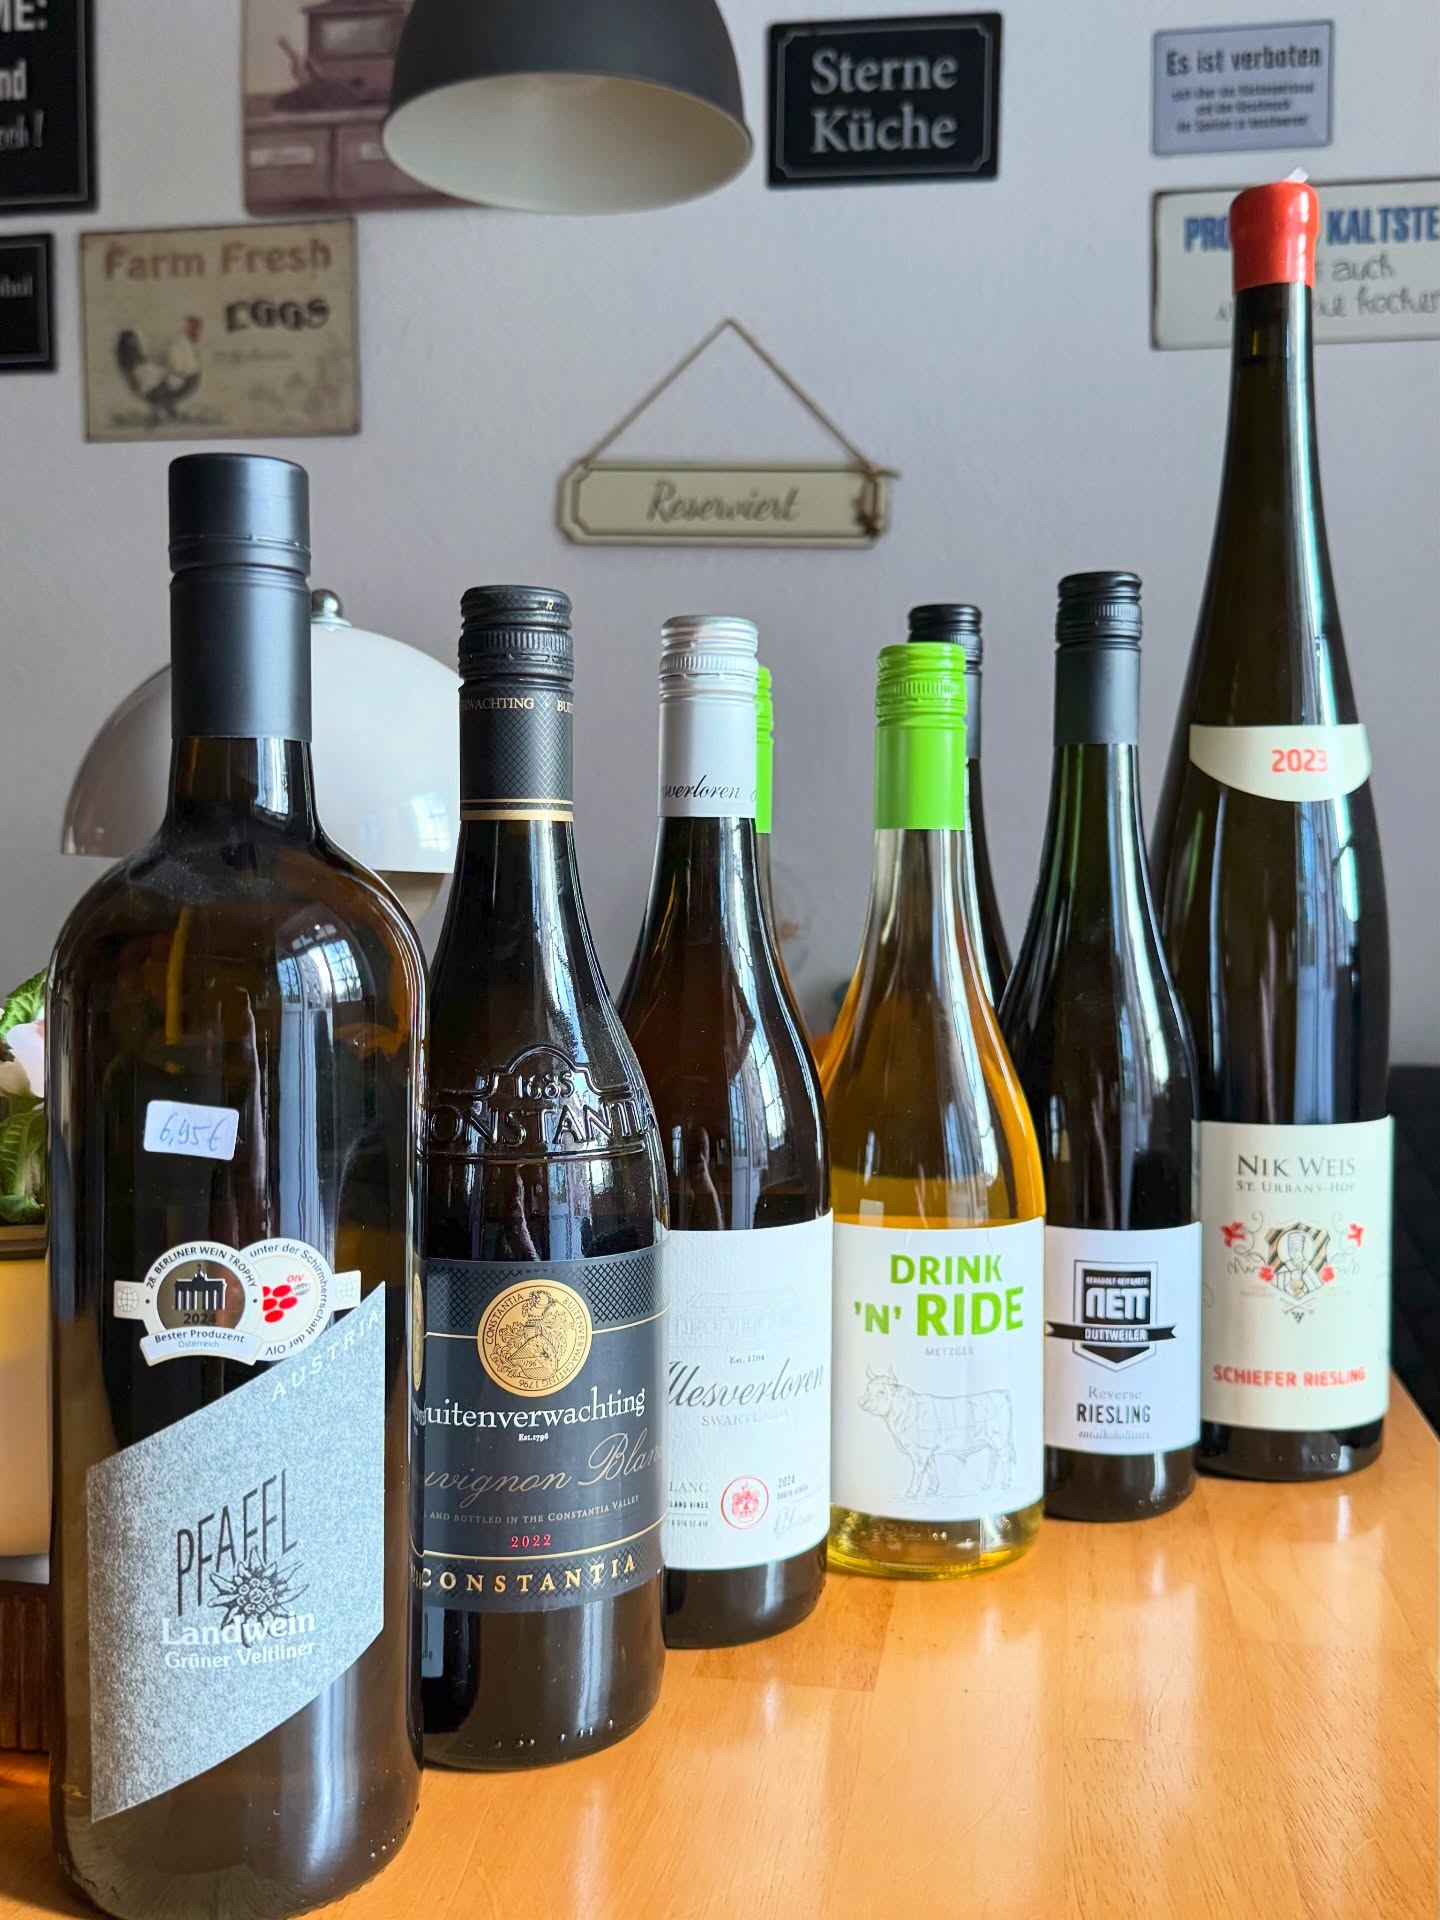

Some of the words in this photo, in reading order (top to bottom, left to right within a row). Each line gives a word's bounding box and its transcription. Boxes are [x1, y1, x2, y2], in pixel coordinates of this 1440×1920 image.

[811, 49, 958, 94] Sterne
[1167, 51, 1190, 76] Es
[1198, 49, 1224, 73] ist
[1230, 45, 1322, 71] verboten
[811, 103, 957, 152] Küche
[105, 245, 205, 281] Farm
[221, 240, 332, 276] Fresh
[464, 698, 535, 711] WACHTING
[1271, 748, 1329, 773] 2023
[1237, 1154, 1288, 1177] NIK
[1298, 1156, 1356, 1177] WEIS
[249, 1243, 280, 1258] unter
[282, 1243, 300, 1254] der
[155, 1246, 197, 1273] BERLINER
[200, 1246, 227, 1258] WEIN
[228, 1255, 257, 1288] TROPHY
[890, 1254, 1003, 1285] DRINK
[184, 1313, 217, 1325] 2024
[486, 1292, 525, 1345] CONSTANTIA
[916, 1286, 1024, 1337] RIDE
[154, 1330, 188, 1343] Bester
[190, 1329, 245, 1343] Produzent
[289, 1333, 305, 1349] der
[1084, 1328, 1149, 1342] DUTTWEILER
[265, 1344, 286, 1356] OIV
[272, 1308, 379, 1402] AUSTRIA
[1213, 1364, 1297, 1388] SCHIEFER
[1303, 1364, 1366, 1387] RIESLING
[1087, 1385, 1144, 1399] Reverse
[425, 1386, 646, 1428] uitenverwachting
[1076, 1403, 1151, 1424] RIESLING
[429, 1511, 450, 1521] AND
[454, 1513, 502, 1524] BOTTLED
[506, 1515, 518, 1525] IN
[522, 1515, 544, 1524] THE
[548, 1504, 610, 1521] CONSTANTIA
[612, 1494, 640, 1509] VALLEY
[177, 1468, 298, 1617] PFAFFL
[511, 1534, 552, 1549] 2022
[160, 1610, 316, 1646] Landwein
[164, 1650, 232, 1669] Grüner
[235, 1641, 315, 1666] Veltliner
